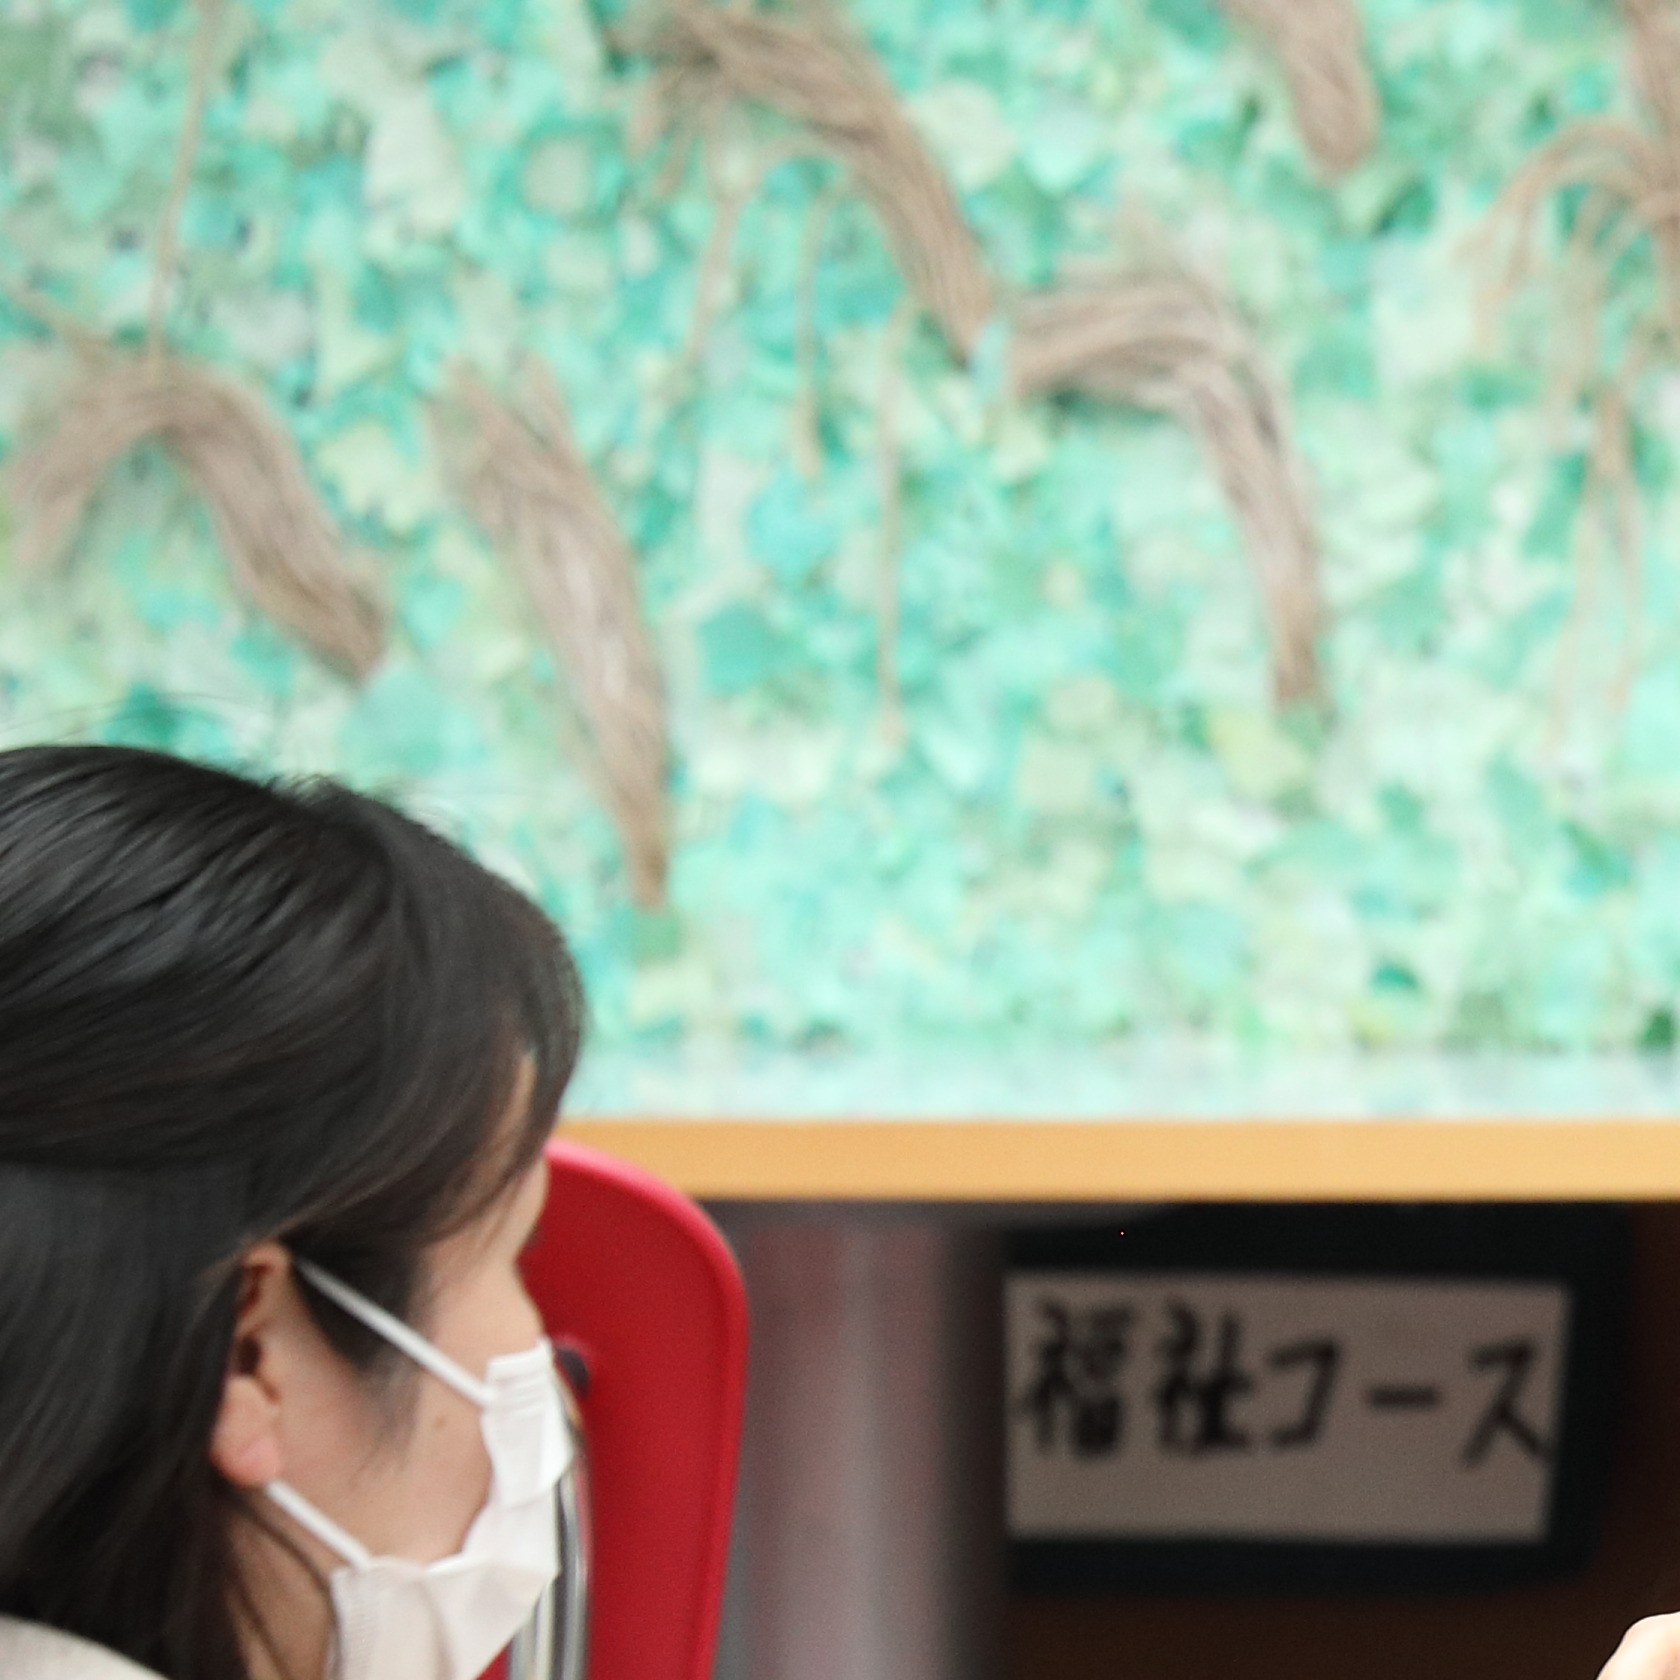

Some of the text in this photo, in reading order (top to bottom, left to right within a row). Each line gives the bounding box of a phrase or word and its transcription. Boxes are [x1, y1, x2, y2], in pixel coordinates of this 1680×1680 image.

[1014, 1296, 1553, 1471] 福祉コース
